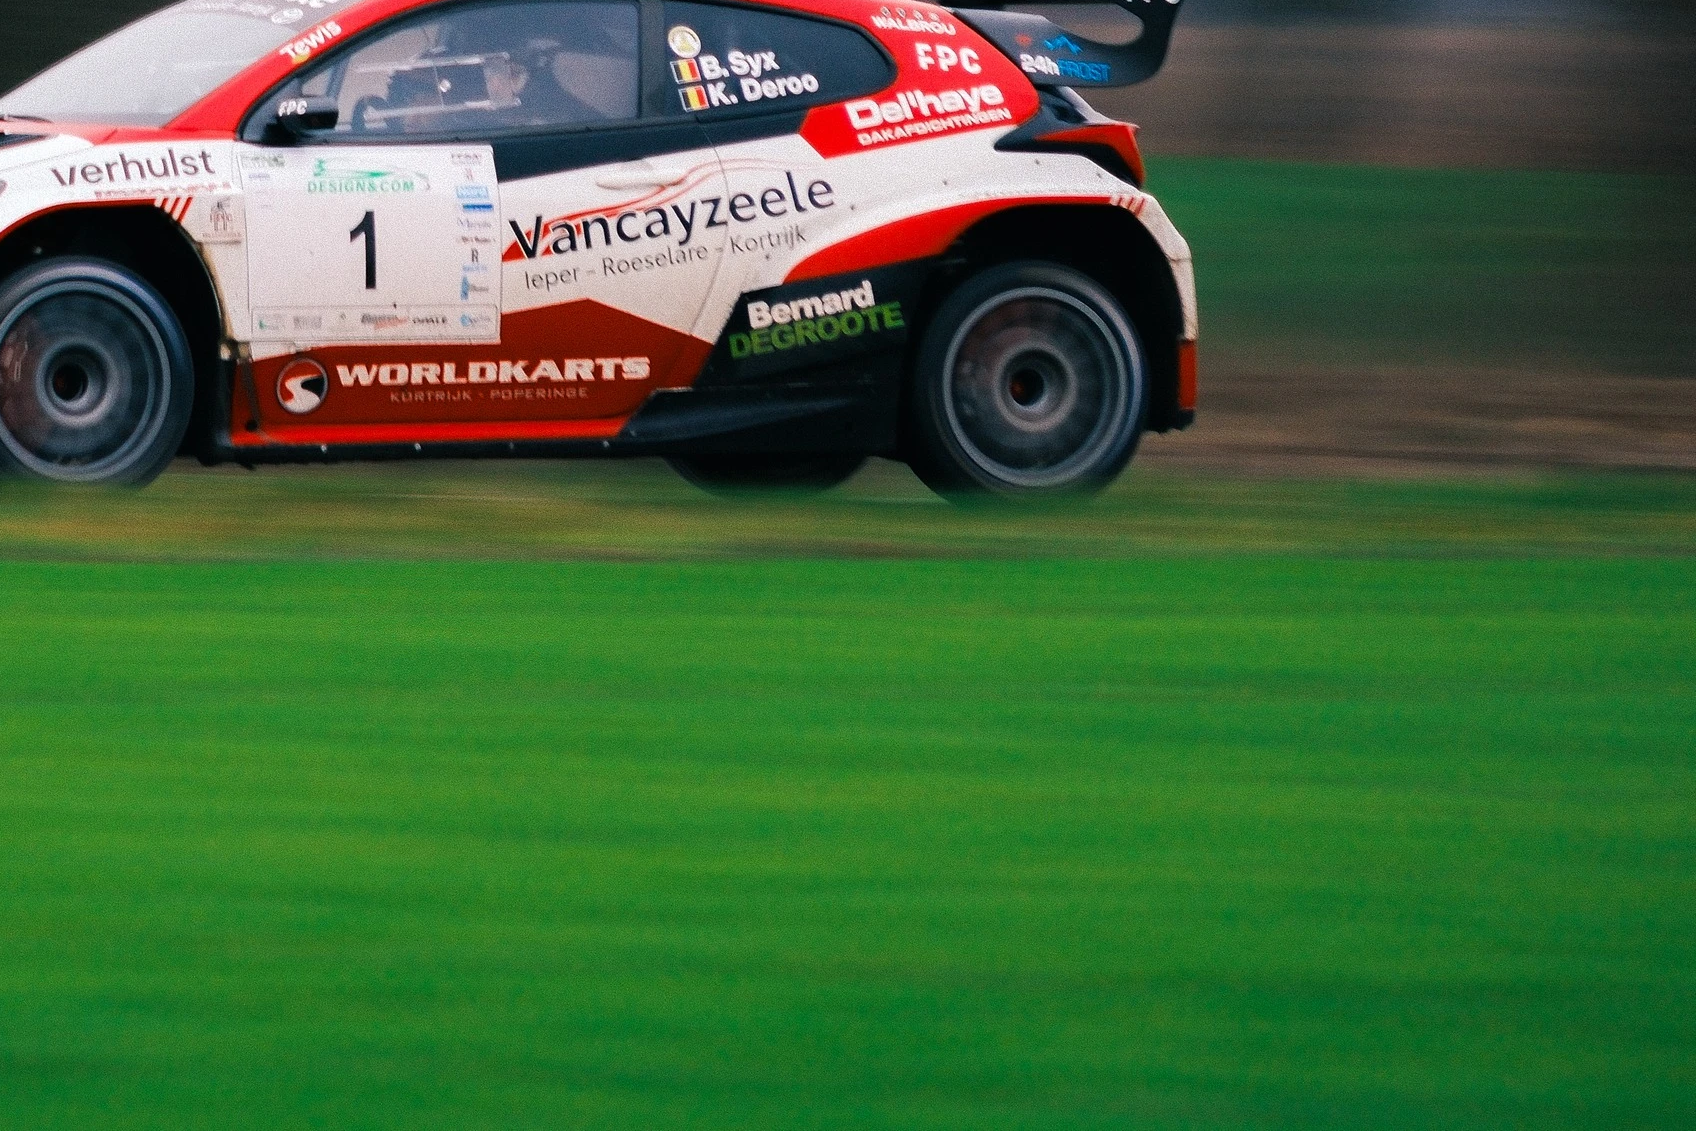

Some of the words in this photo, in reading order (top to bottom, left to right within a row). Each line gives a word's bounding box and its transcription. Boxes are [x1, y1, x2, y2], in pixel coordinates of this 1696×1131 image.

[698, 55, 730, 80] B.
[727, 48, 781, 78] Syx
[915, 42, 982, 75] FPC
[706, 82, 739, 108] K.
[739, 73, 820, 103] Deroo
[844, 84, 1005, 130] Del'haye
[508, 170, 836, 261] Vancayzeele
[350, 209, 376, 290] 1
[524, 267, 579, 291] Ieper
[602, 243, 709, 272] Roeselare
[730, 223, 808, 256] Kortrijk
[747, 279, 876, 330] Bernard
[728, 300, 906, 360] DEGROOTE
[336, 356, 651, 388] WORLDKARTS
